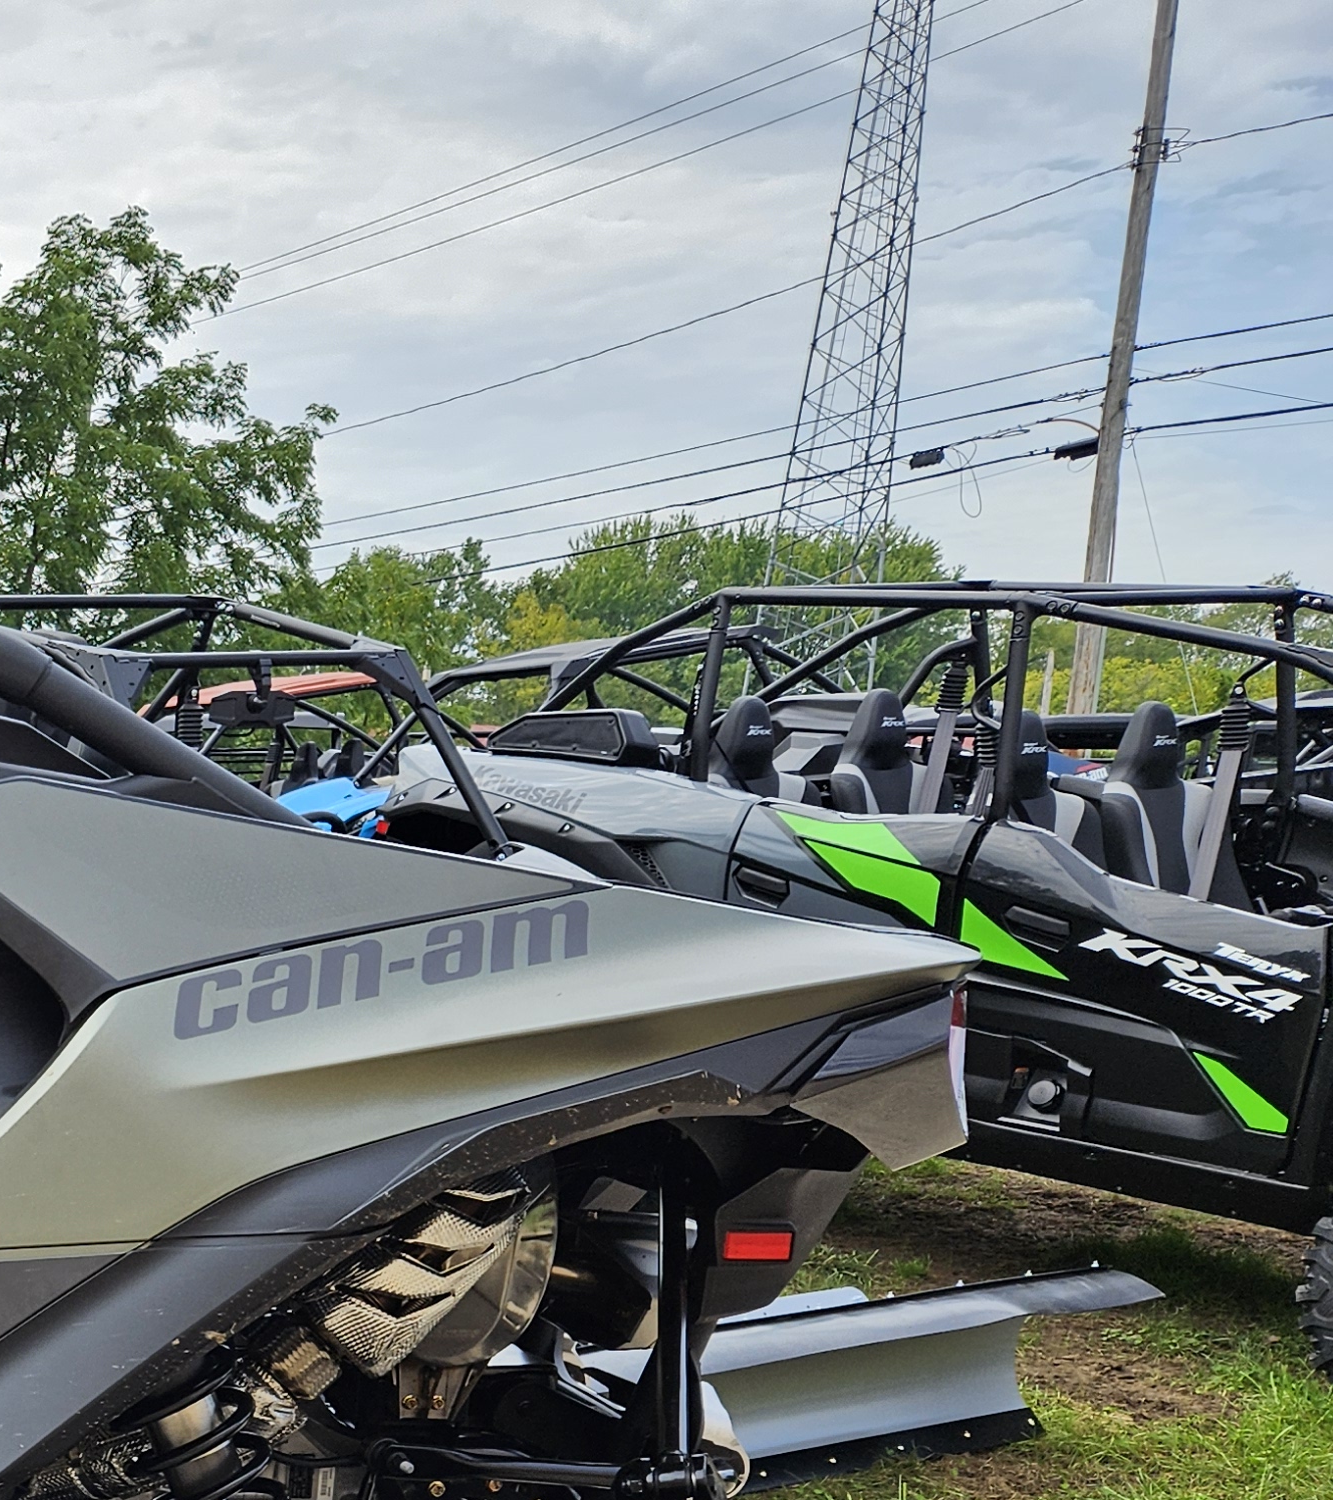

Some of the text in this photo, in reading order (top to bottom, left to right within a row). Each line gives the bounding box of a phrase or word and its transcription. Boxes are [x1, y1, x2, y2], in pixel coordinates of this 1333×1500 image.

[473, 765, 588, 815] Kawasaki
[173, 899, 590, 1041] can-am
[1077, 927, 1304, 1012] KRX4
